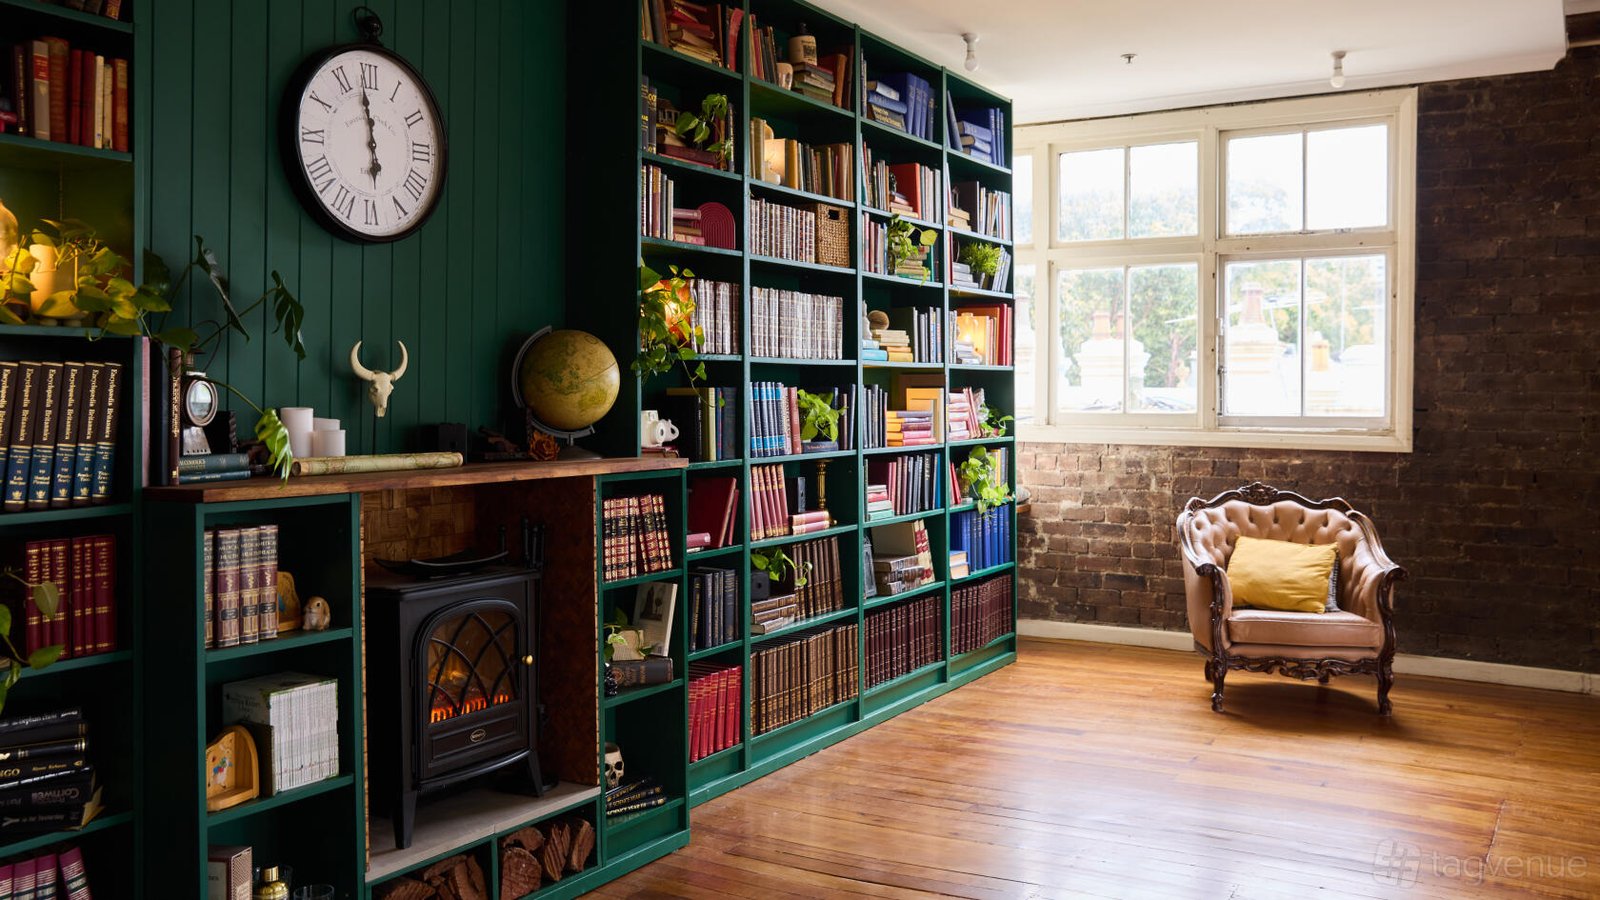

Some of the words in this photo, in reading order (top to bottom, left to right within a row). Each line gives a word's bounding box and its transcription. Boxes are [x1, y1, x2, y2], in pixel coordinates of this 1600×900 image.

[331, 65, 353, 96] XI
[359, 62, 379, 91] XII
[309, 90, 333, 114] X
[389, 80, 402, 103] I
[404, 108, 424, 129] II
[301, 126, 325, 146] IX
[412, 141, 430, 164] III
[306, 154, 337, 196] VIII
[403, 168, 427, 202] IIII
[330, 184, 357, 220] VII
[364, 199, 379, 226] VI
[393, 195, 409, 220] V
